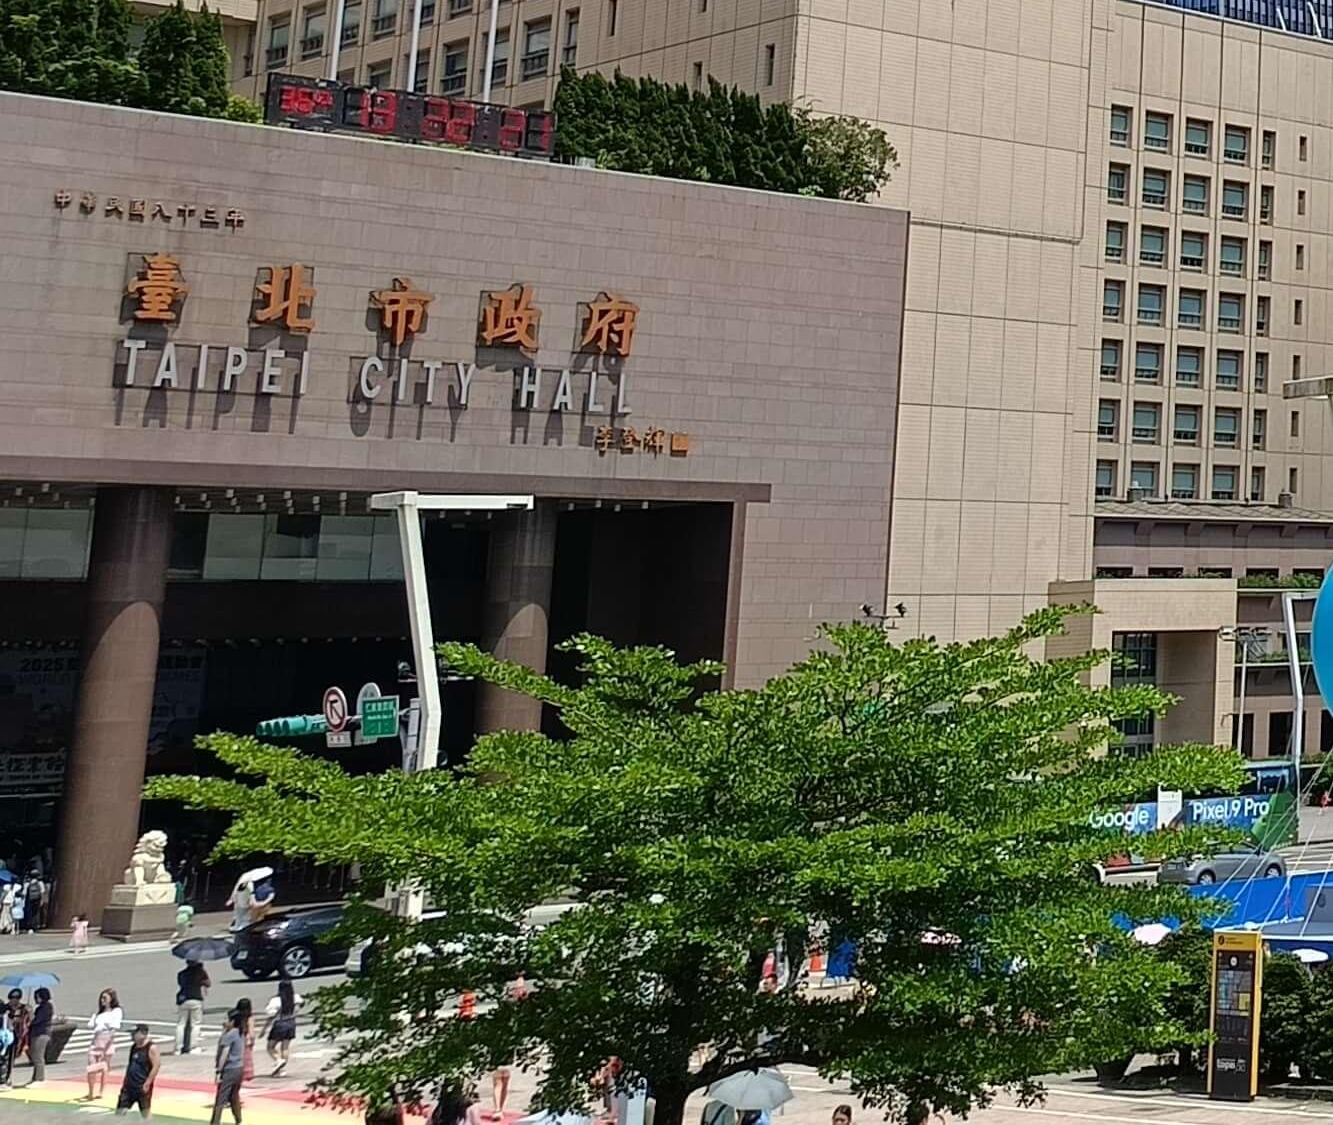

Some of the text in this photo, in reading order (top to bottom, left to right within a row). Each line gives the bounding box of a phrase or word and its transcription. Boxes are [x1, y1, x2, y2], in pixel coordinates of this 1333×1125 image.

[127, 251, 641, 356] 臺北市政府
[123, 339, 633, 414] TAIPEI CITY HALL
[1089, 797, 1270, 832] Google Pixel 9 Pro
